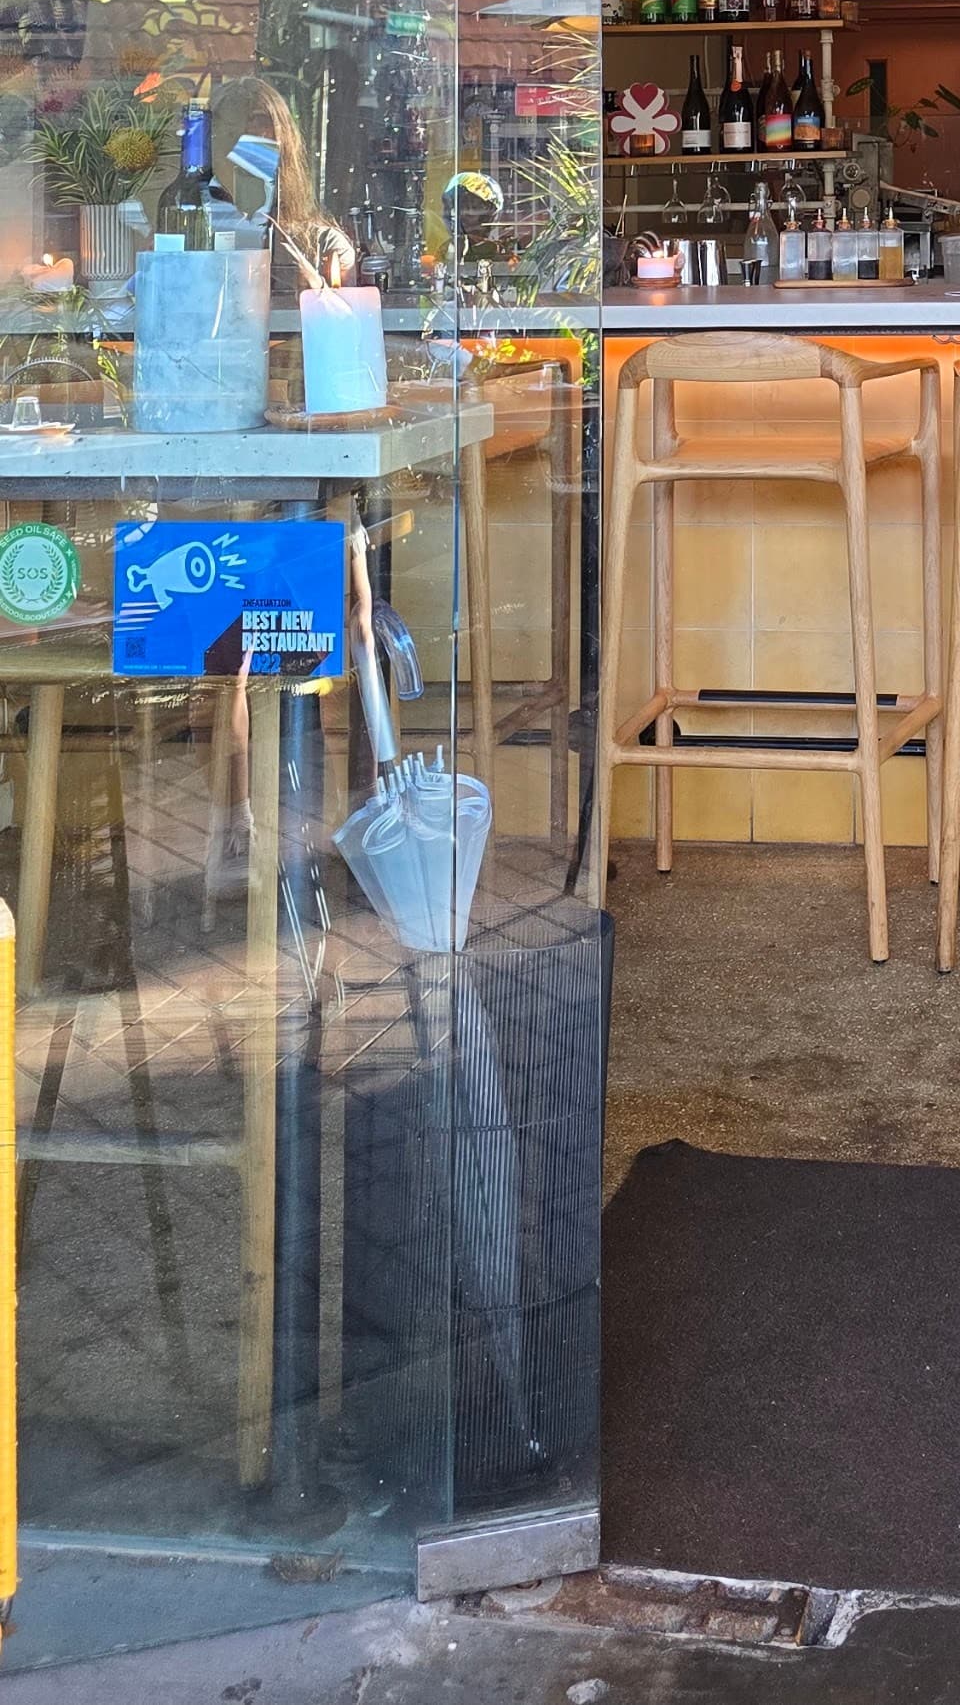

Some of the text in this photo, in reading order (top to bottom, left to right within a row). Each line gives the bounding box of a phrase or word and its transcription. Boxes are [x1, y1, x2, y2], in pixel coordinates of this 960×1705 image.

[25, 525, 42, 534] OIL
[42, 527, 68, 547] SAFE
[17, 567, 49, 580] SOS
[242, 610, 314, 631] BEST NEW
[241, 631, 336, 652] RESTAURANT
[241, 652, 281, 673] 022
